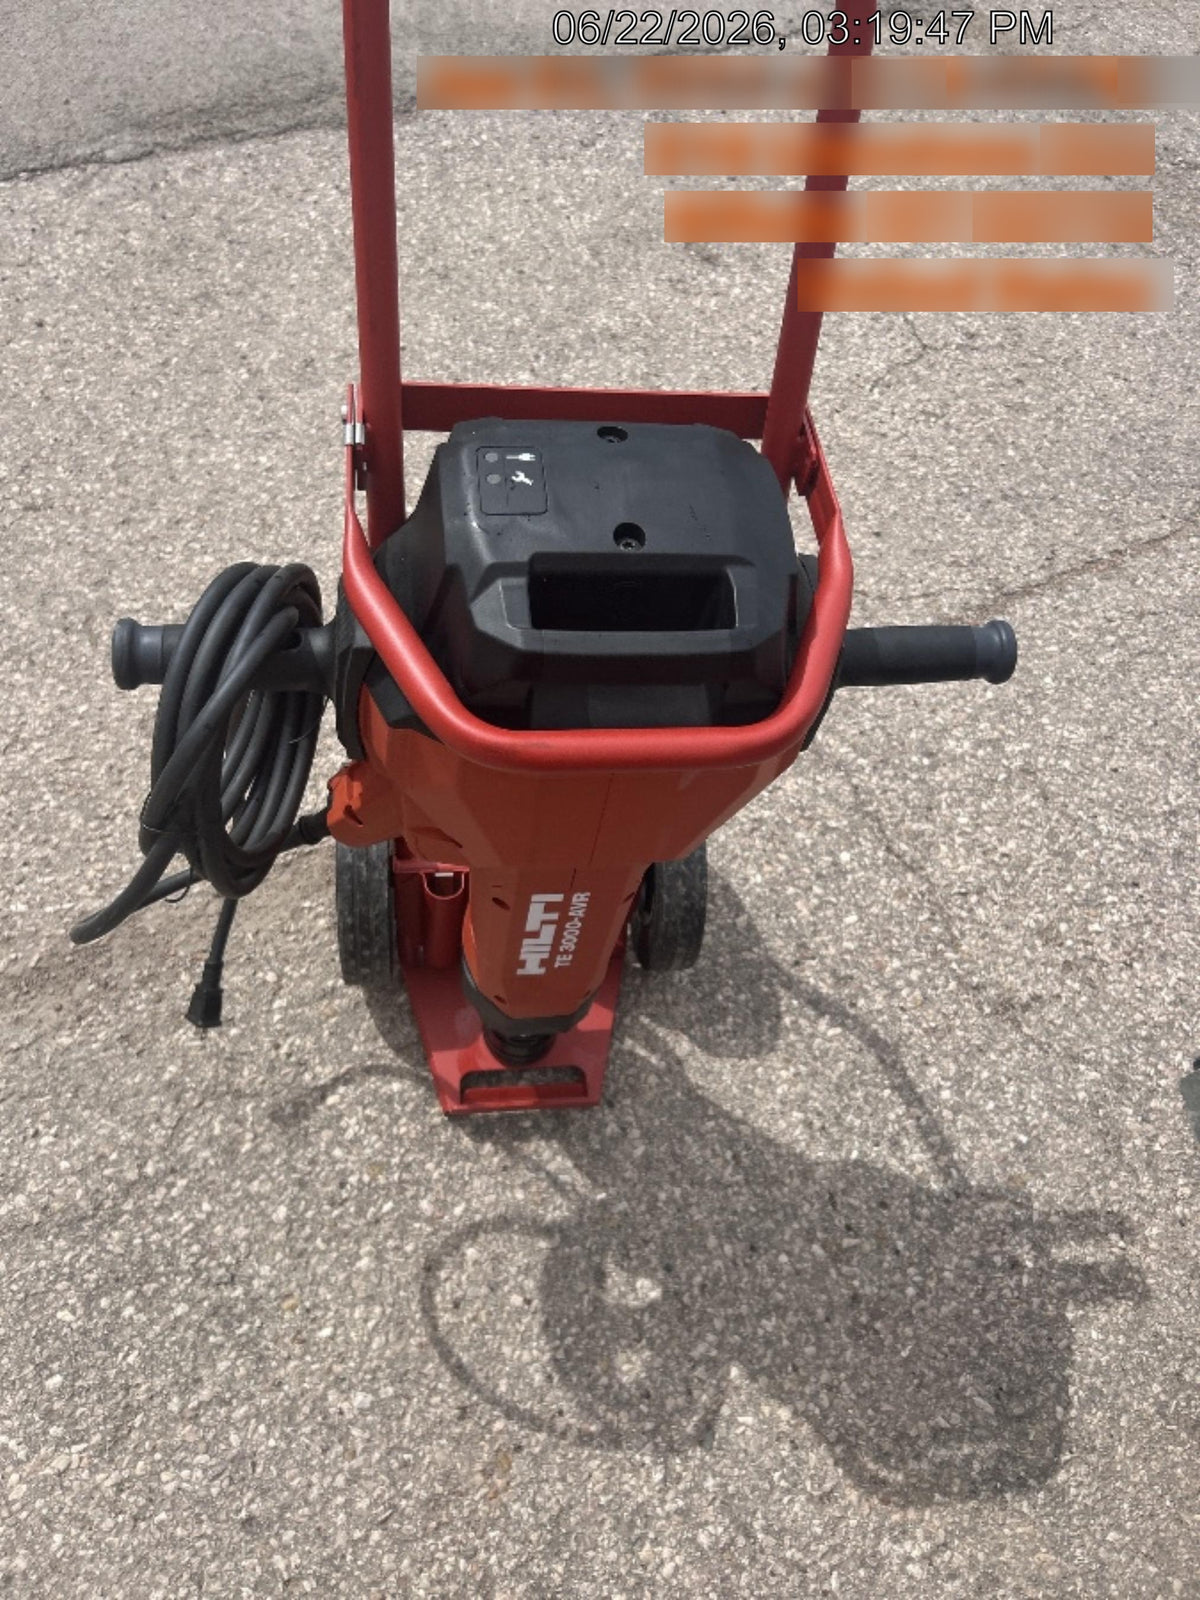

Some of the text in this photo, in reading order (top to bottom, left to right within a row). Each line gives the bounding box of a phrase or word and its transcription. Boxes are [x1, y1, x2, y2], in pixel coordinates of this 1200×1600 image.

[516, 893, 564, 975] HILTI
[554, 892, 591, 968] TE 3000-AVR
